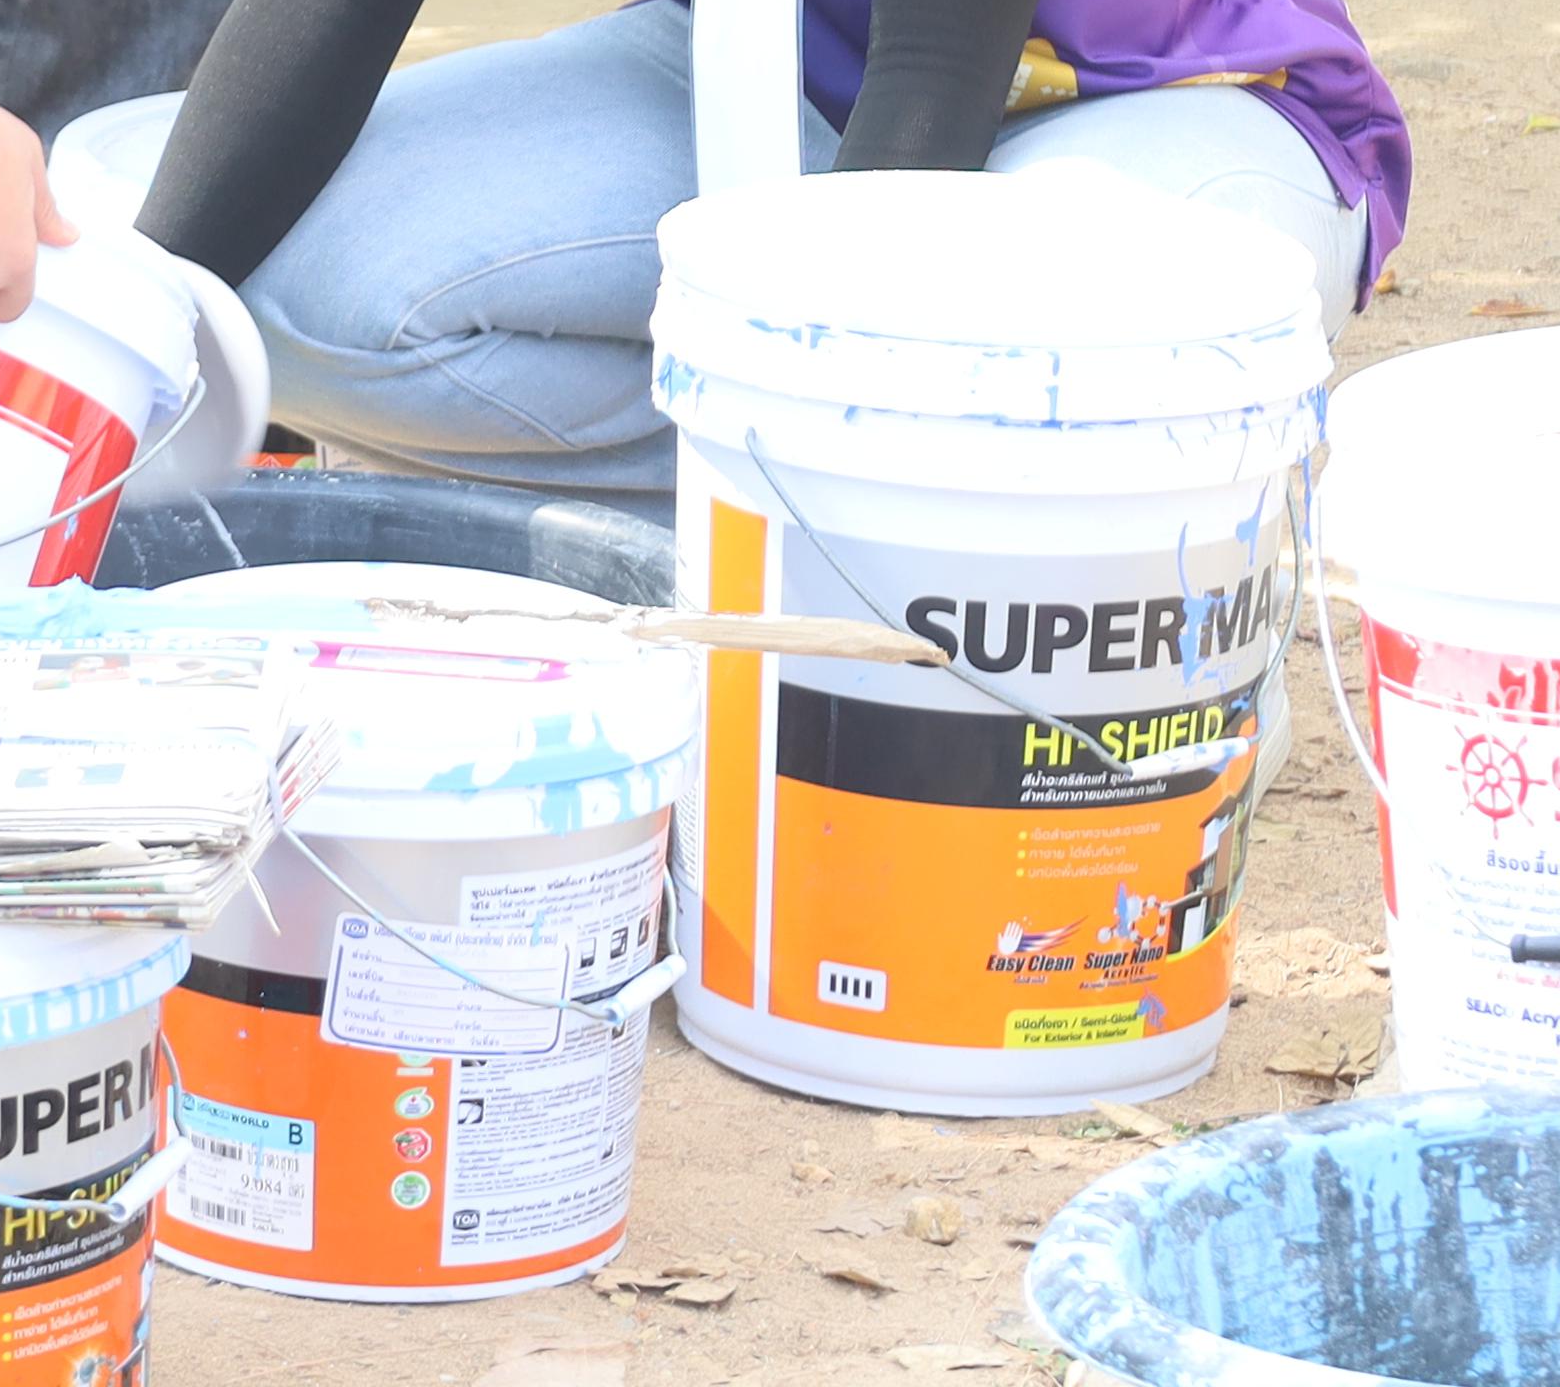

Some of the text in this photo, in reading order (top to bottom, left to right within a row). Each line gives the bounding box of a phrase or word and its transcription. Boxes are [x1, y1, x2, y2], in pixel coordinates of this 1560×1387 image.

[905, 595, 1186, 674] SUPER
[345, 922, 367, 934] TOA
[985, 945, 1165, 974] Easy Clean Super Nano
[1102, 966, 1146, 980] Acrylic
[1080, 1011, 1138, 1029] Semi-Gloss
[1023, 1034, 1041, 1044] For
[1044, 1031, 1083, 1044] Exterior
[1095, 1027, 1128, 1040] Interior
[231, 1113, 270, 1129] WORLD
[288, 1122, 304, 1146] B
[2, 1152, 152, 1246] HI-SHIE
[454, 1213, 478, 1227] TOA
